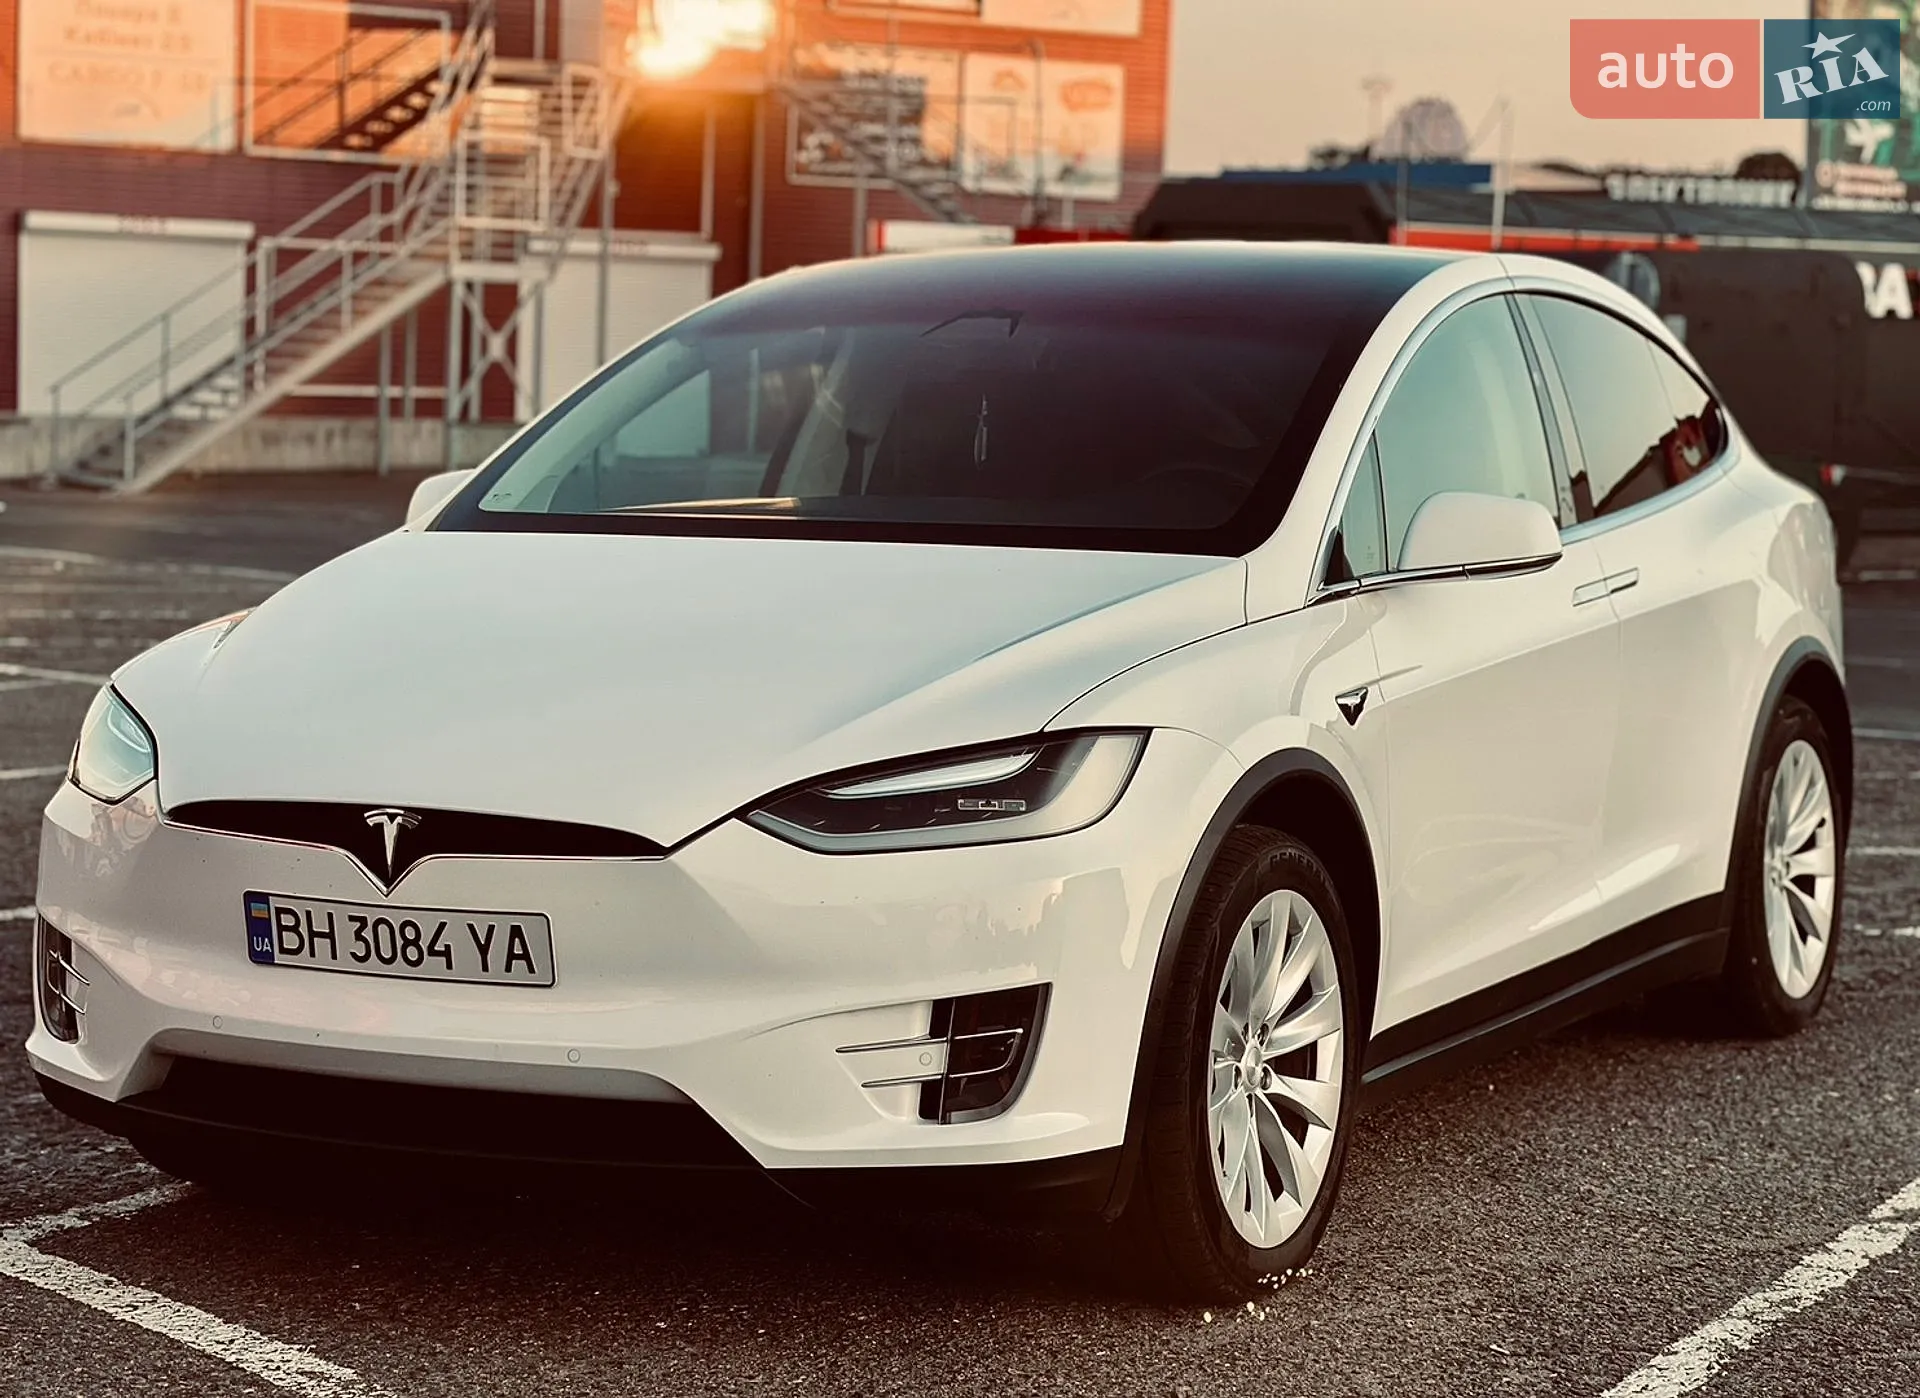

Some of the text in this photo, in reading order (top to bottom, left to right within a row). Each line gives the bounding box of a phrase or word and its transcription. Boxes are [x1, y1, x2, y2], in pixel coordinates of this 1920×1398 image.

[253, 936, 271, 953] UA
[274, 906, 536, 974] BH 3084 YA
